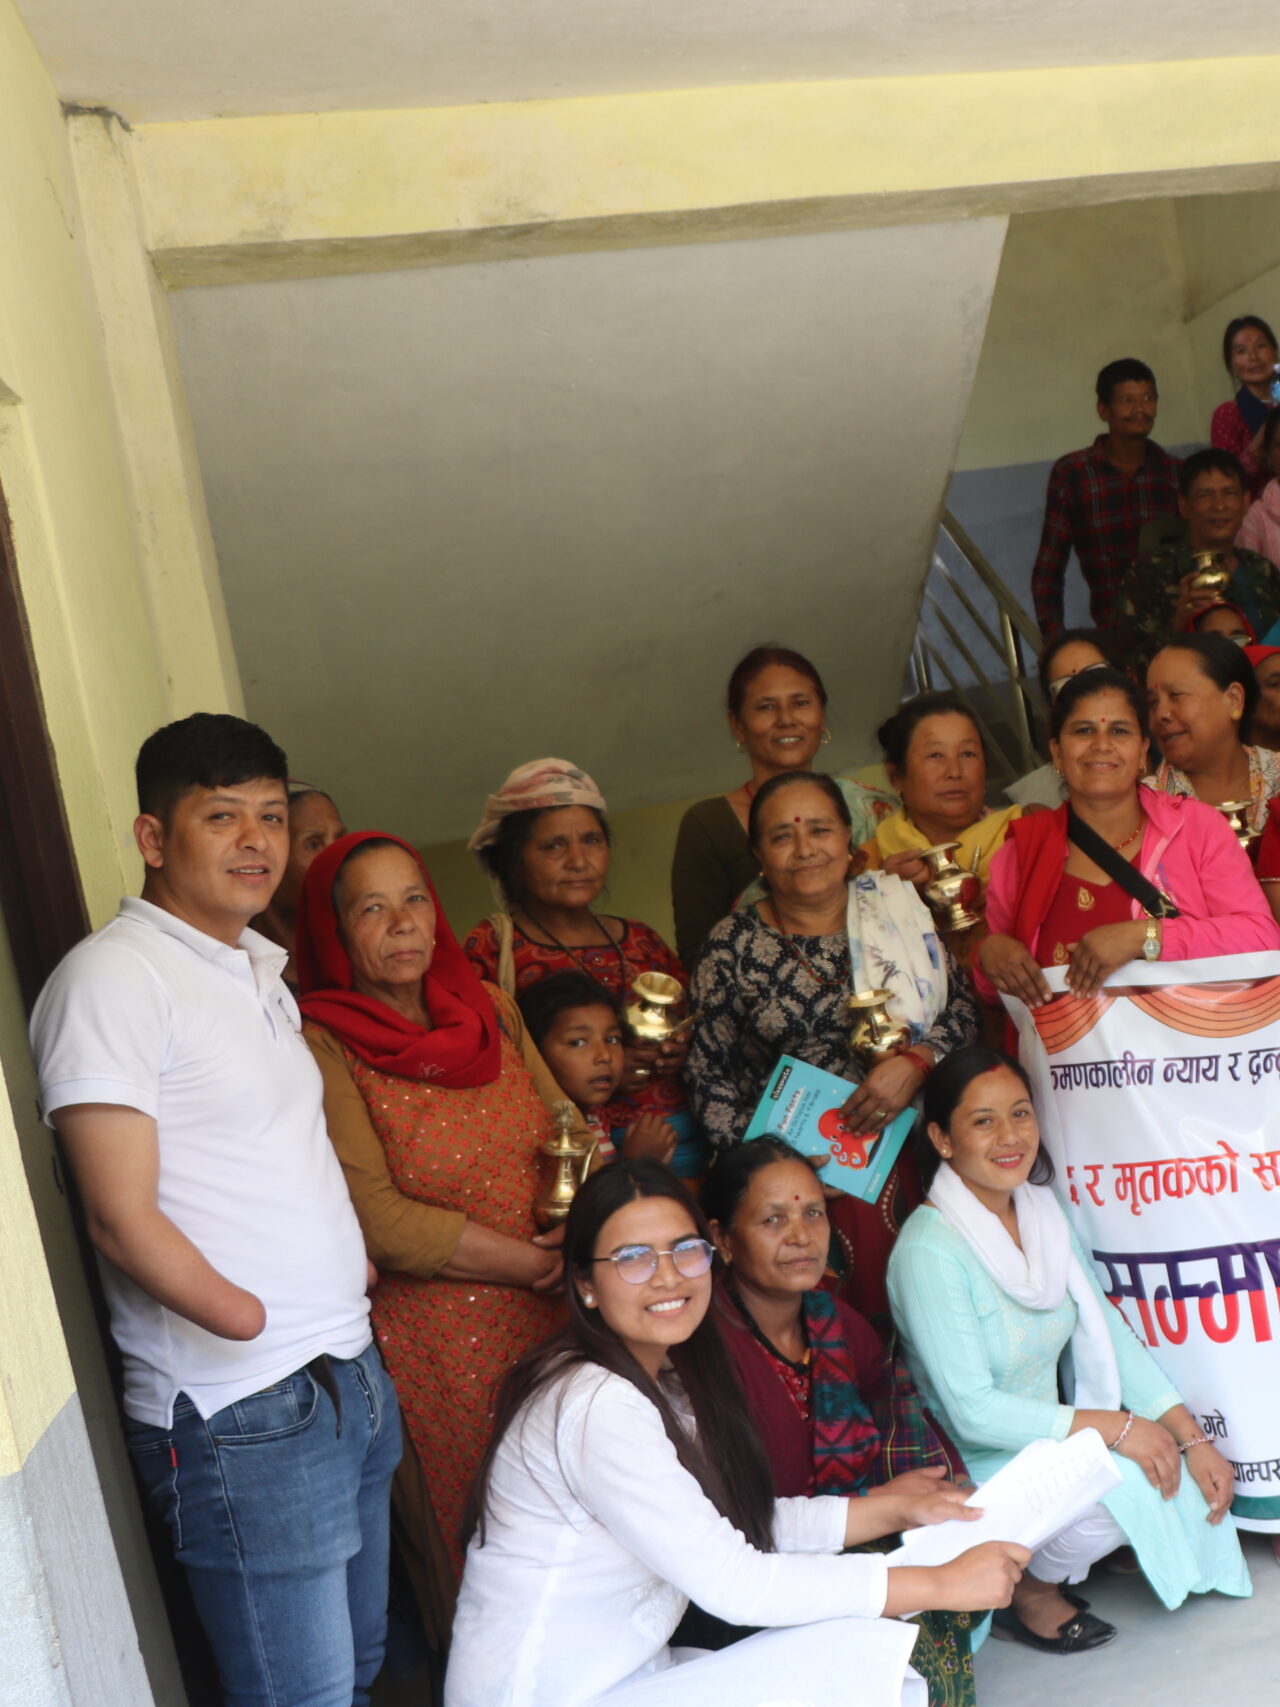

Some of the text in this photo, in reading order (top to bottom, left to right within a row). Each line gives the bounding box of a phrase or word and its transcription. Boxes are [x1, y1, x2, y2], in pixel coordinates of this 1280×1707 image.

[1163, 1055, 1221, 1084] न्याय
[1228, 1052, 1243, 1081] र
[1083, 1164, 1105, 1207] र
[1113, 1140, 1240, 1216] मृतकको
[1201, 1408, 1229, 1439] गते
